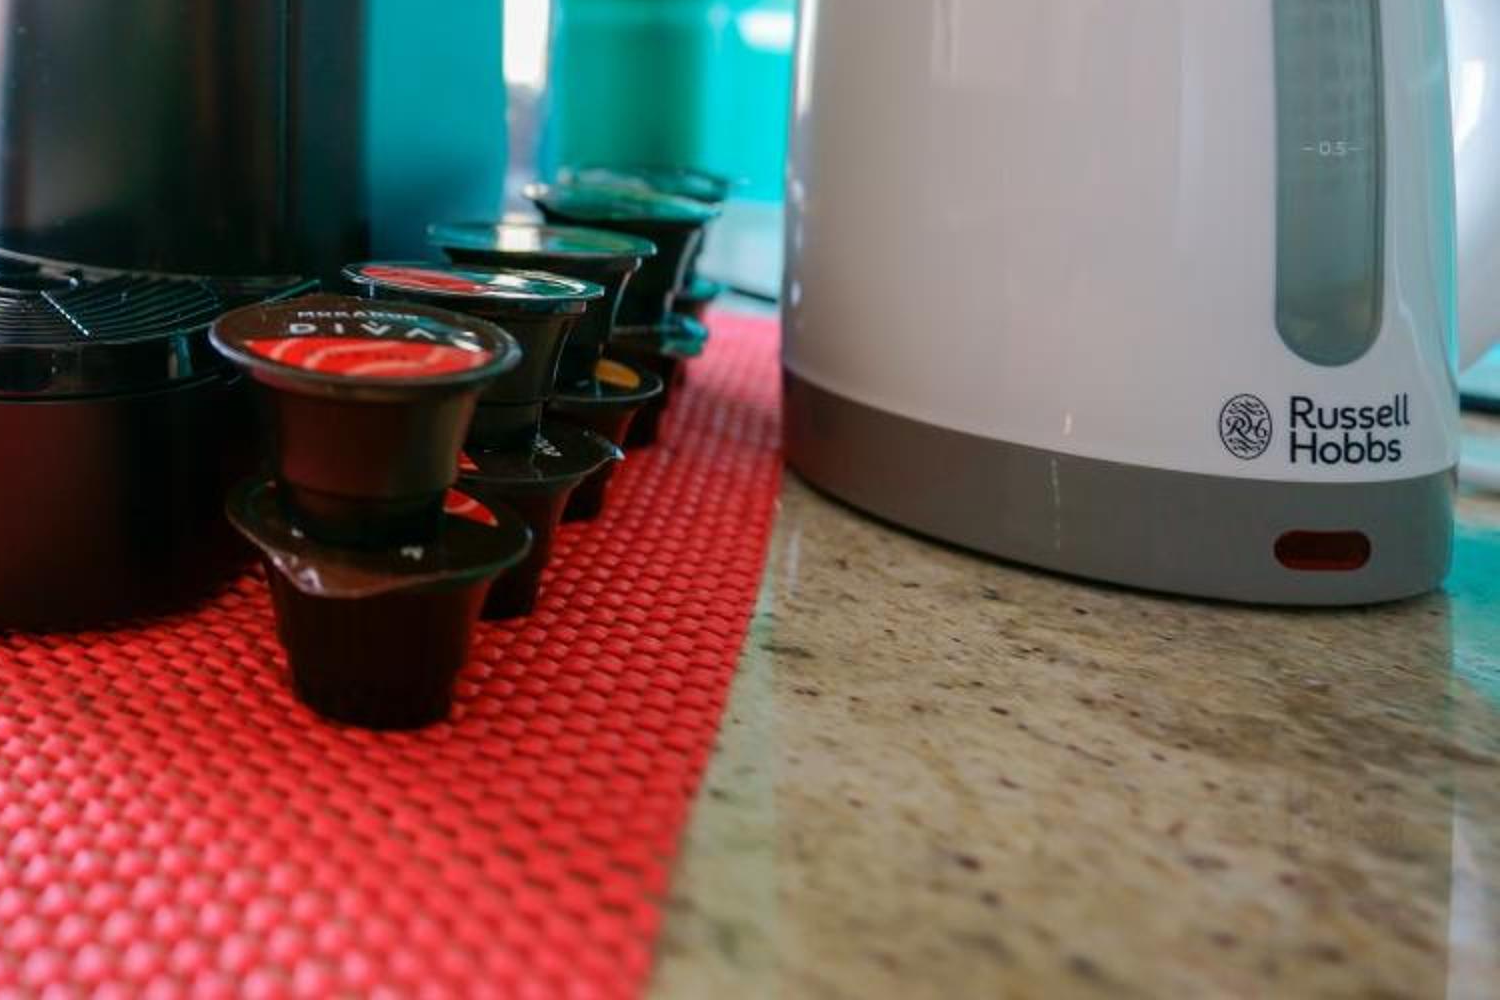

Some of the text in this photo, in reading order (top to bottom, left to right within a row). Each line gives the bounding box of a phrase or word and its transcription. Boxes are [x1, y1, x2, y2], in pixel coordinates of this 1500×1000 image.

[288, 321, 437, 341] DIVA
[1289, 392, 1410, 430] Russell
[1289, 431, 1402, 465] Hobbs
